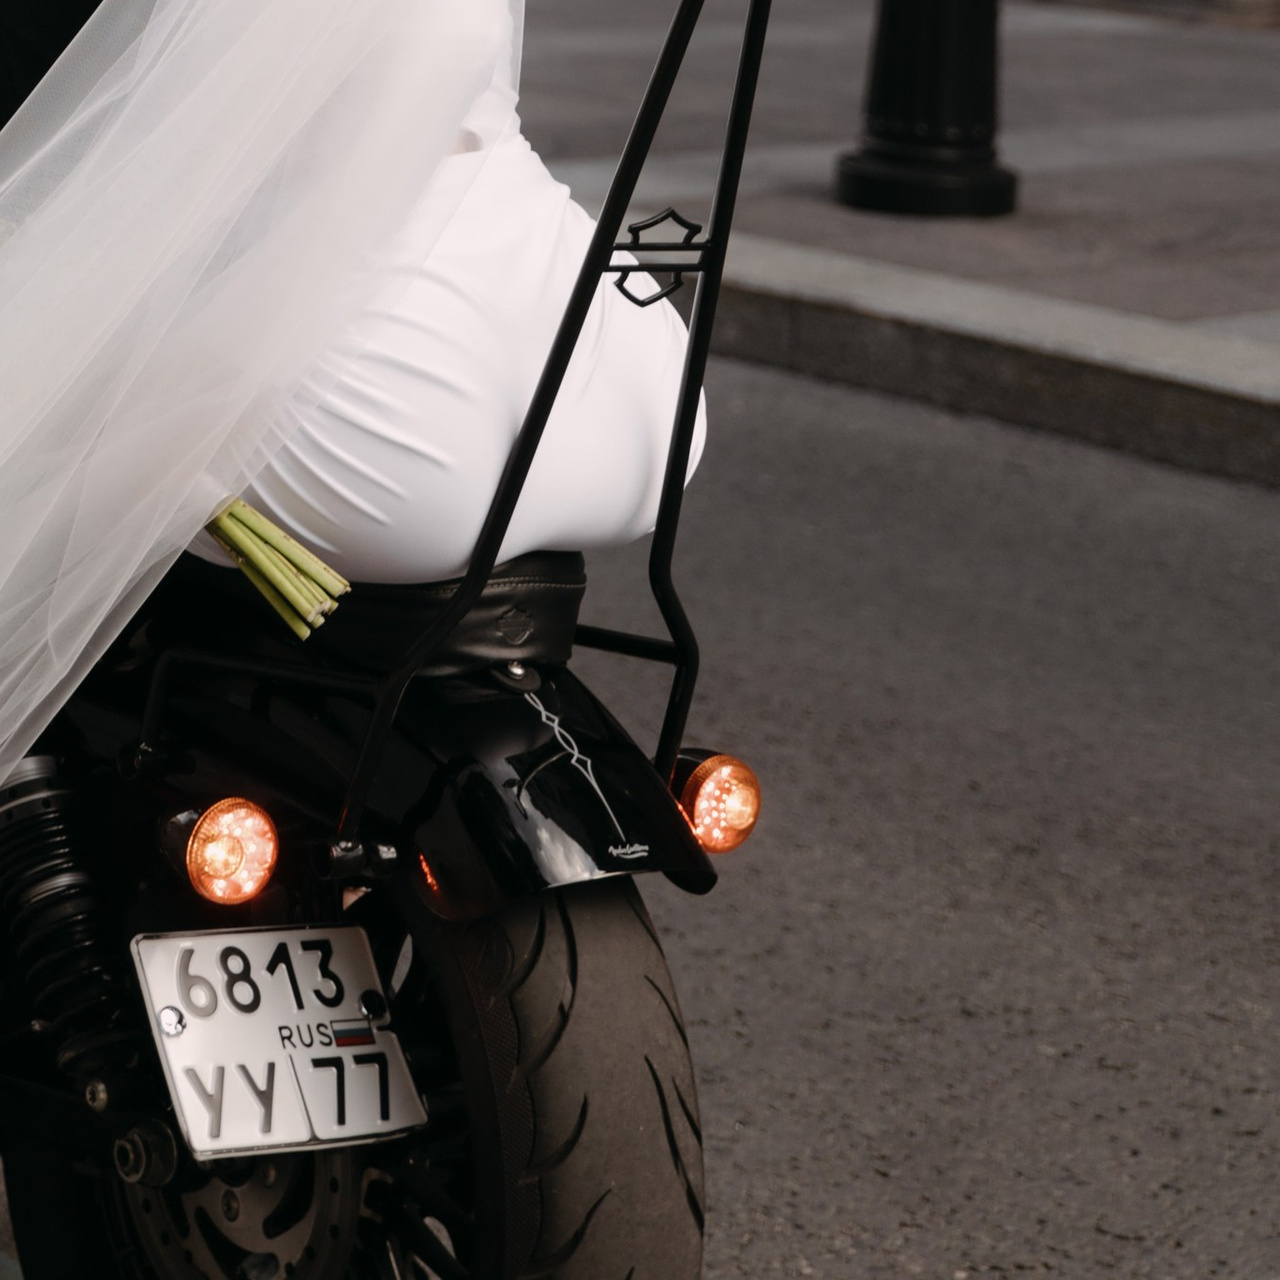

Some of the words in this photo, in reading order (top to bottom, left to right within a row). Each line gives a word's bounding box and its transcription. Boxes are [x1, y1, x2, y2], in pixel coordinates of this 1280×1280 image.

[176, 939, 345, 1018] 6813
[278, 1023, 334, 1050] RUS
[310, 1052, 390, 1126] 77
